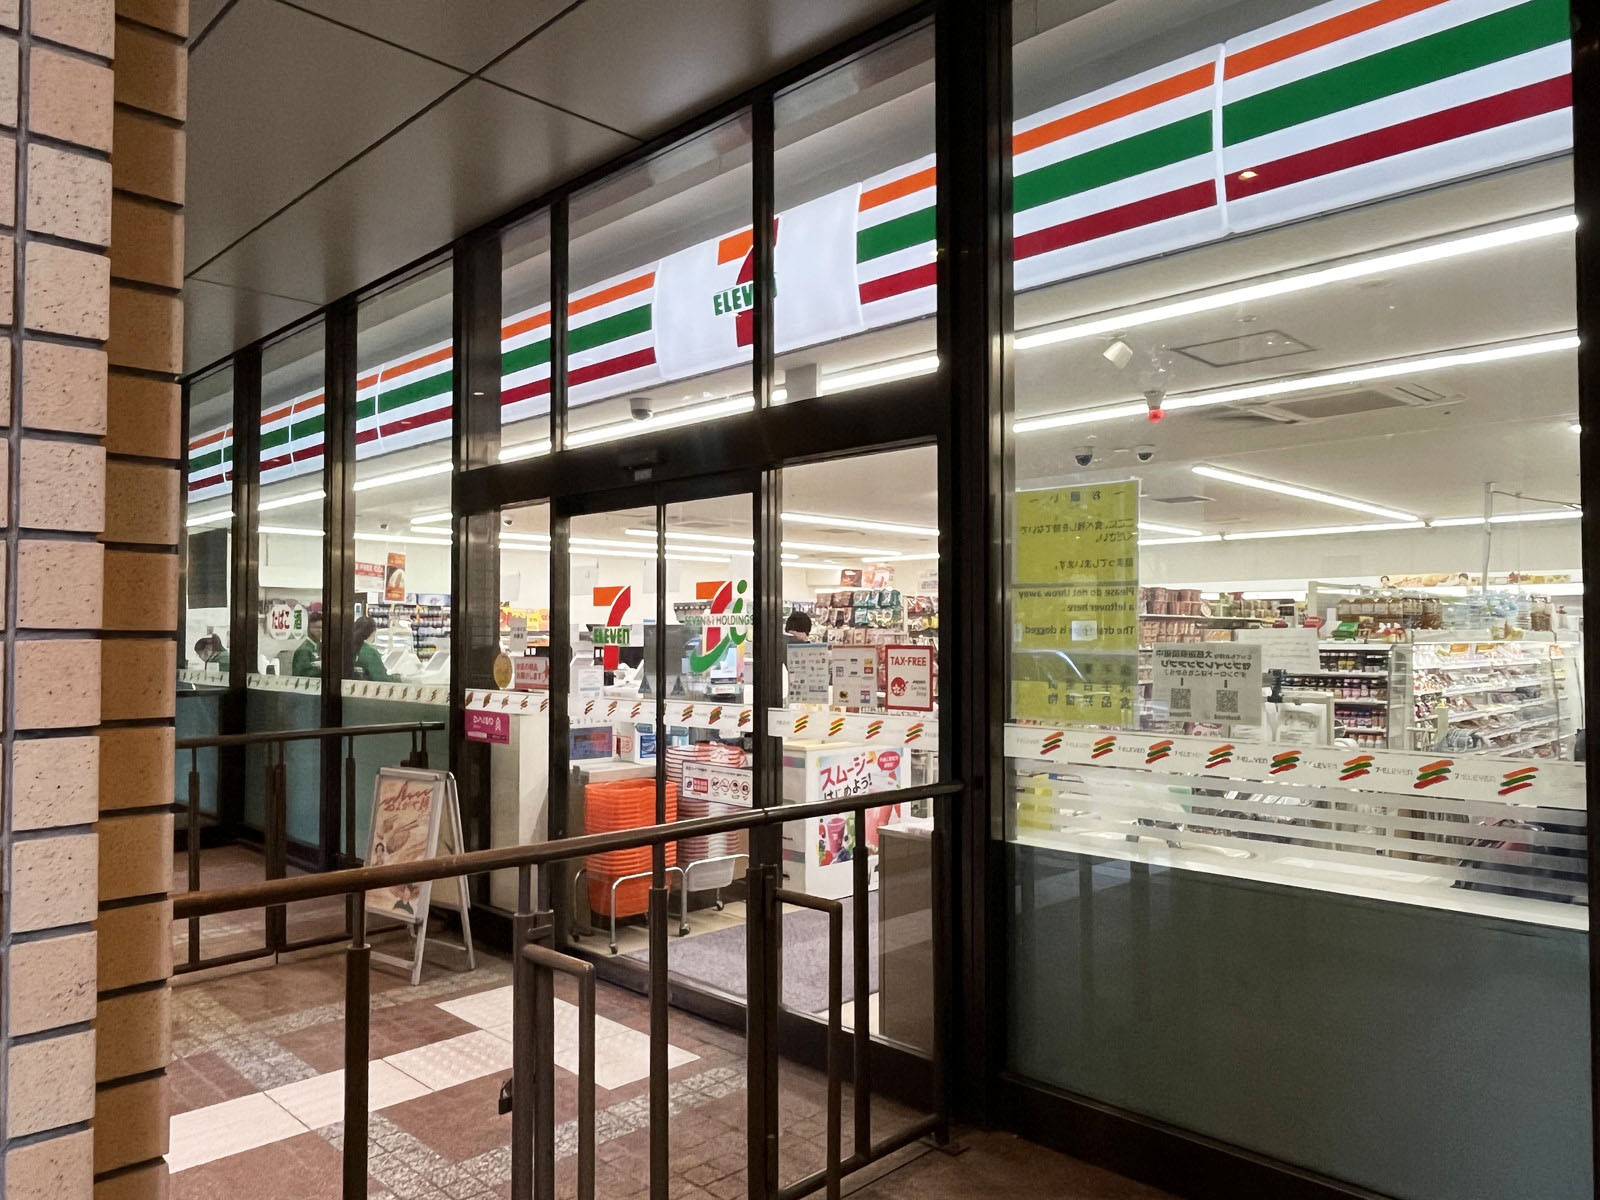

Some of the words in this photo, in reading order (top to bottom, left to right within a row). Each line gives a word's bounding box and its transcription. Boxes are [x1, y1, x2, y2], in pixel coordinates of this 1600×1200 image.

[716, 614, 754, 626] HOLDINGS
[890, 656, 927, 667] TAX-FREE
[820, 752, 874, 792] スムージー
